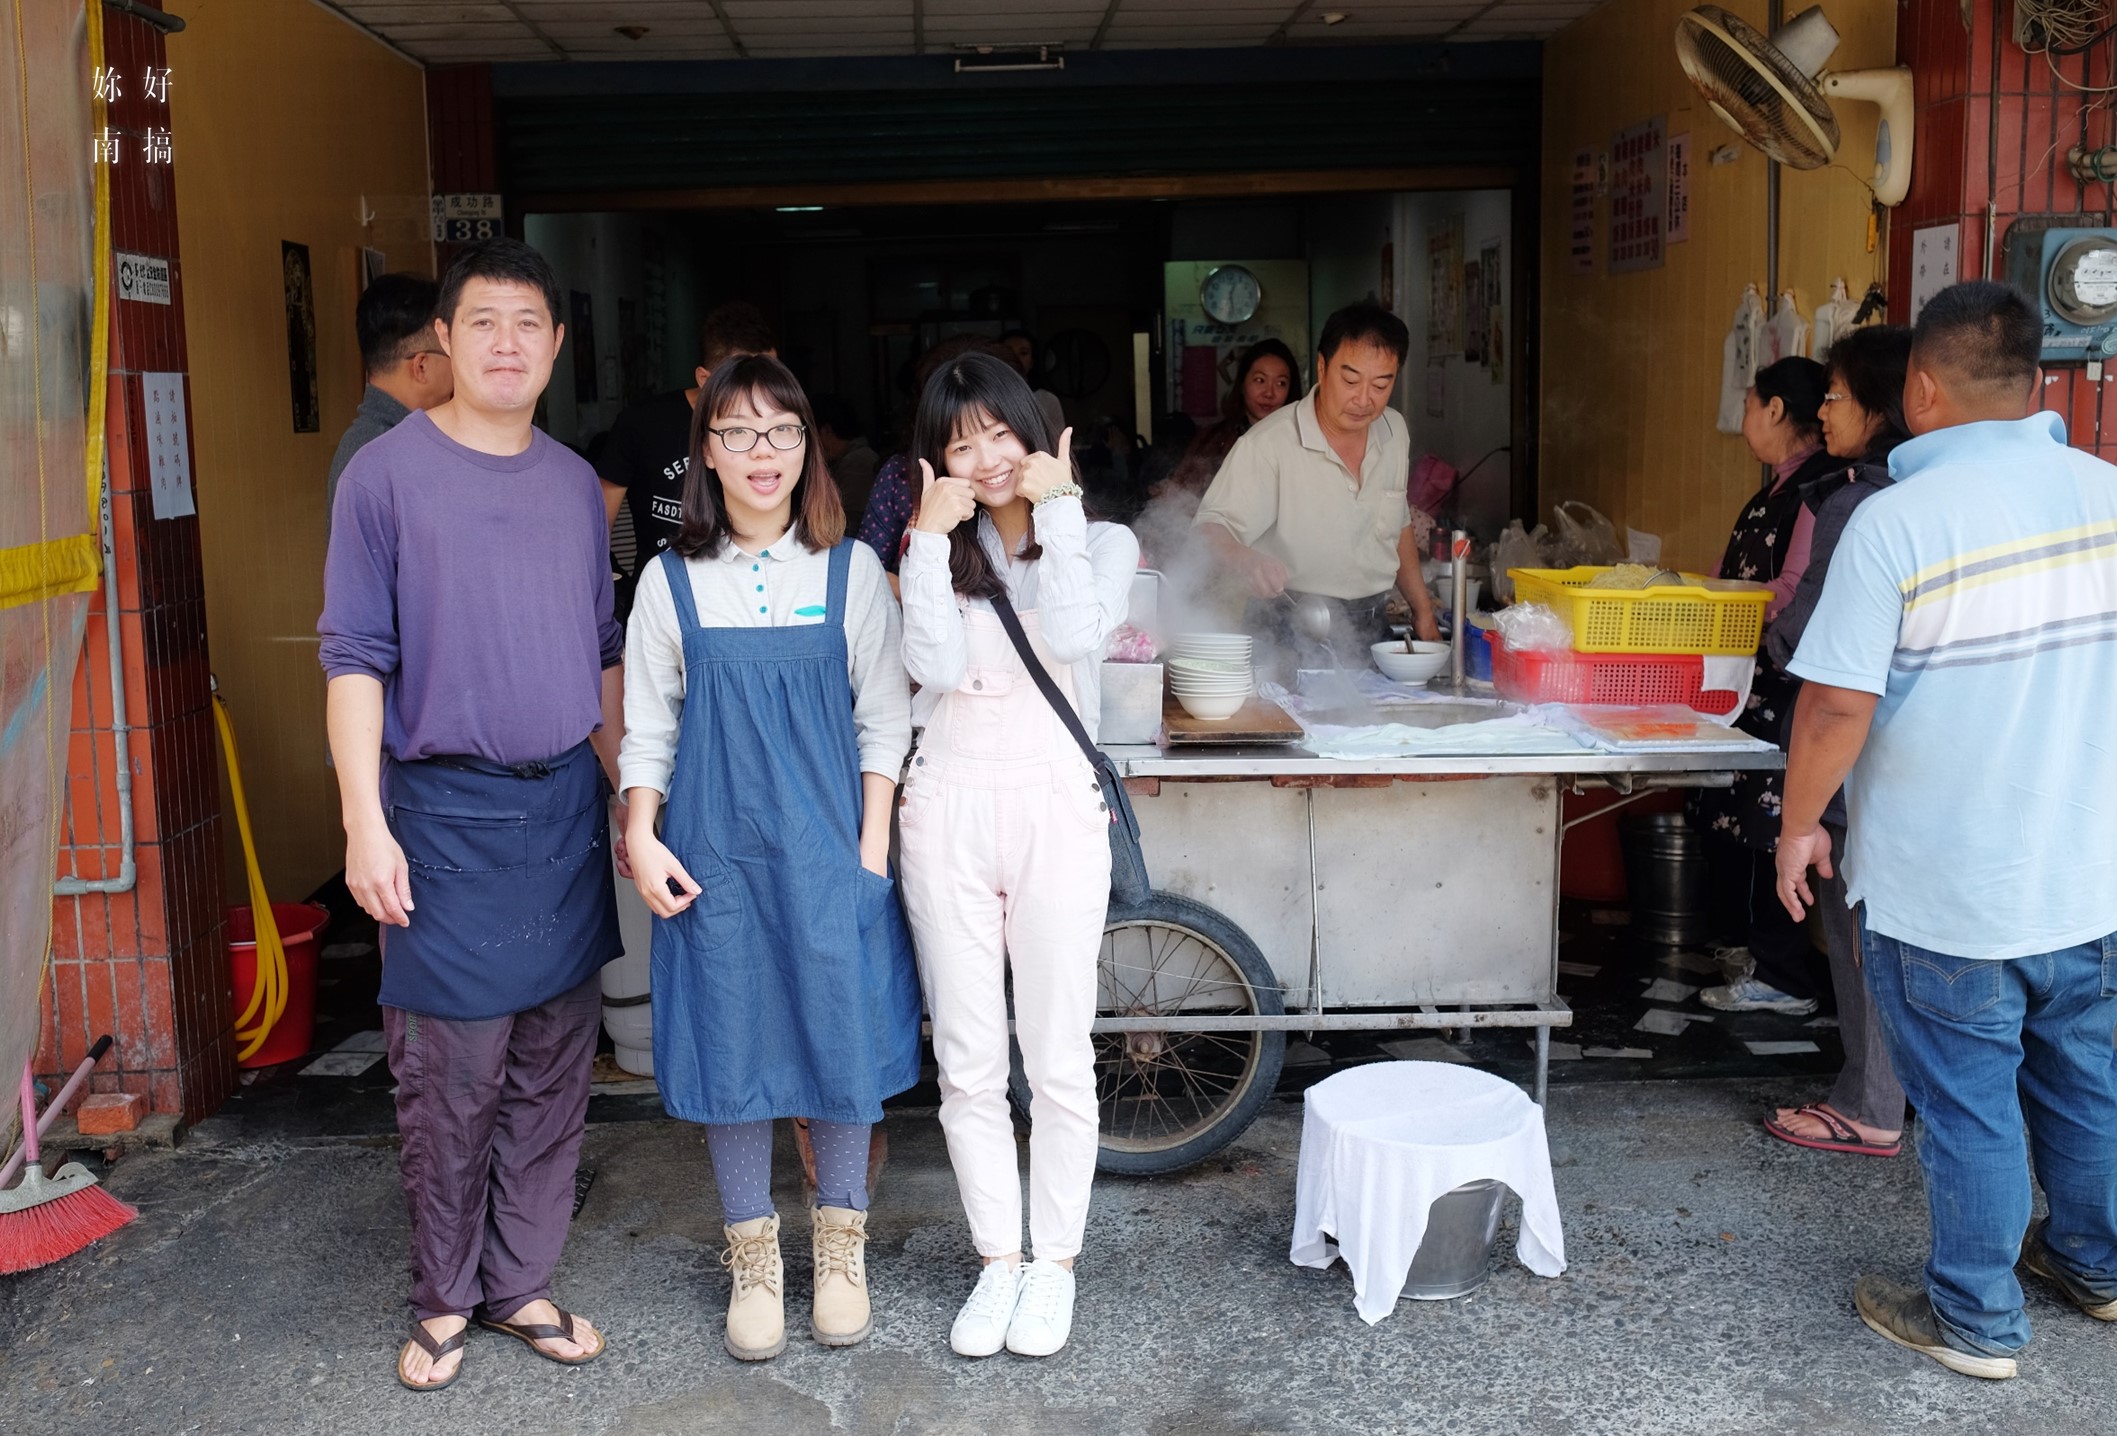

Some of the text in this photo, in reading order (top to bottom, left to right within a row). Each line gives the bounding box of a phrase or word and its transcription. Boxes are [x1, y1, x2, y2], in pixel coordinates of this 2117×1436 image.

[450, 196, 494, 209] 成功路
[456, 219, 492, 241] 38
